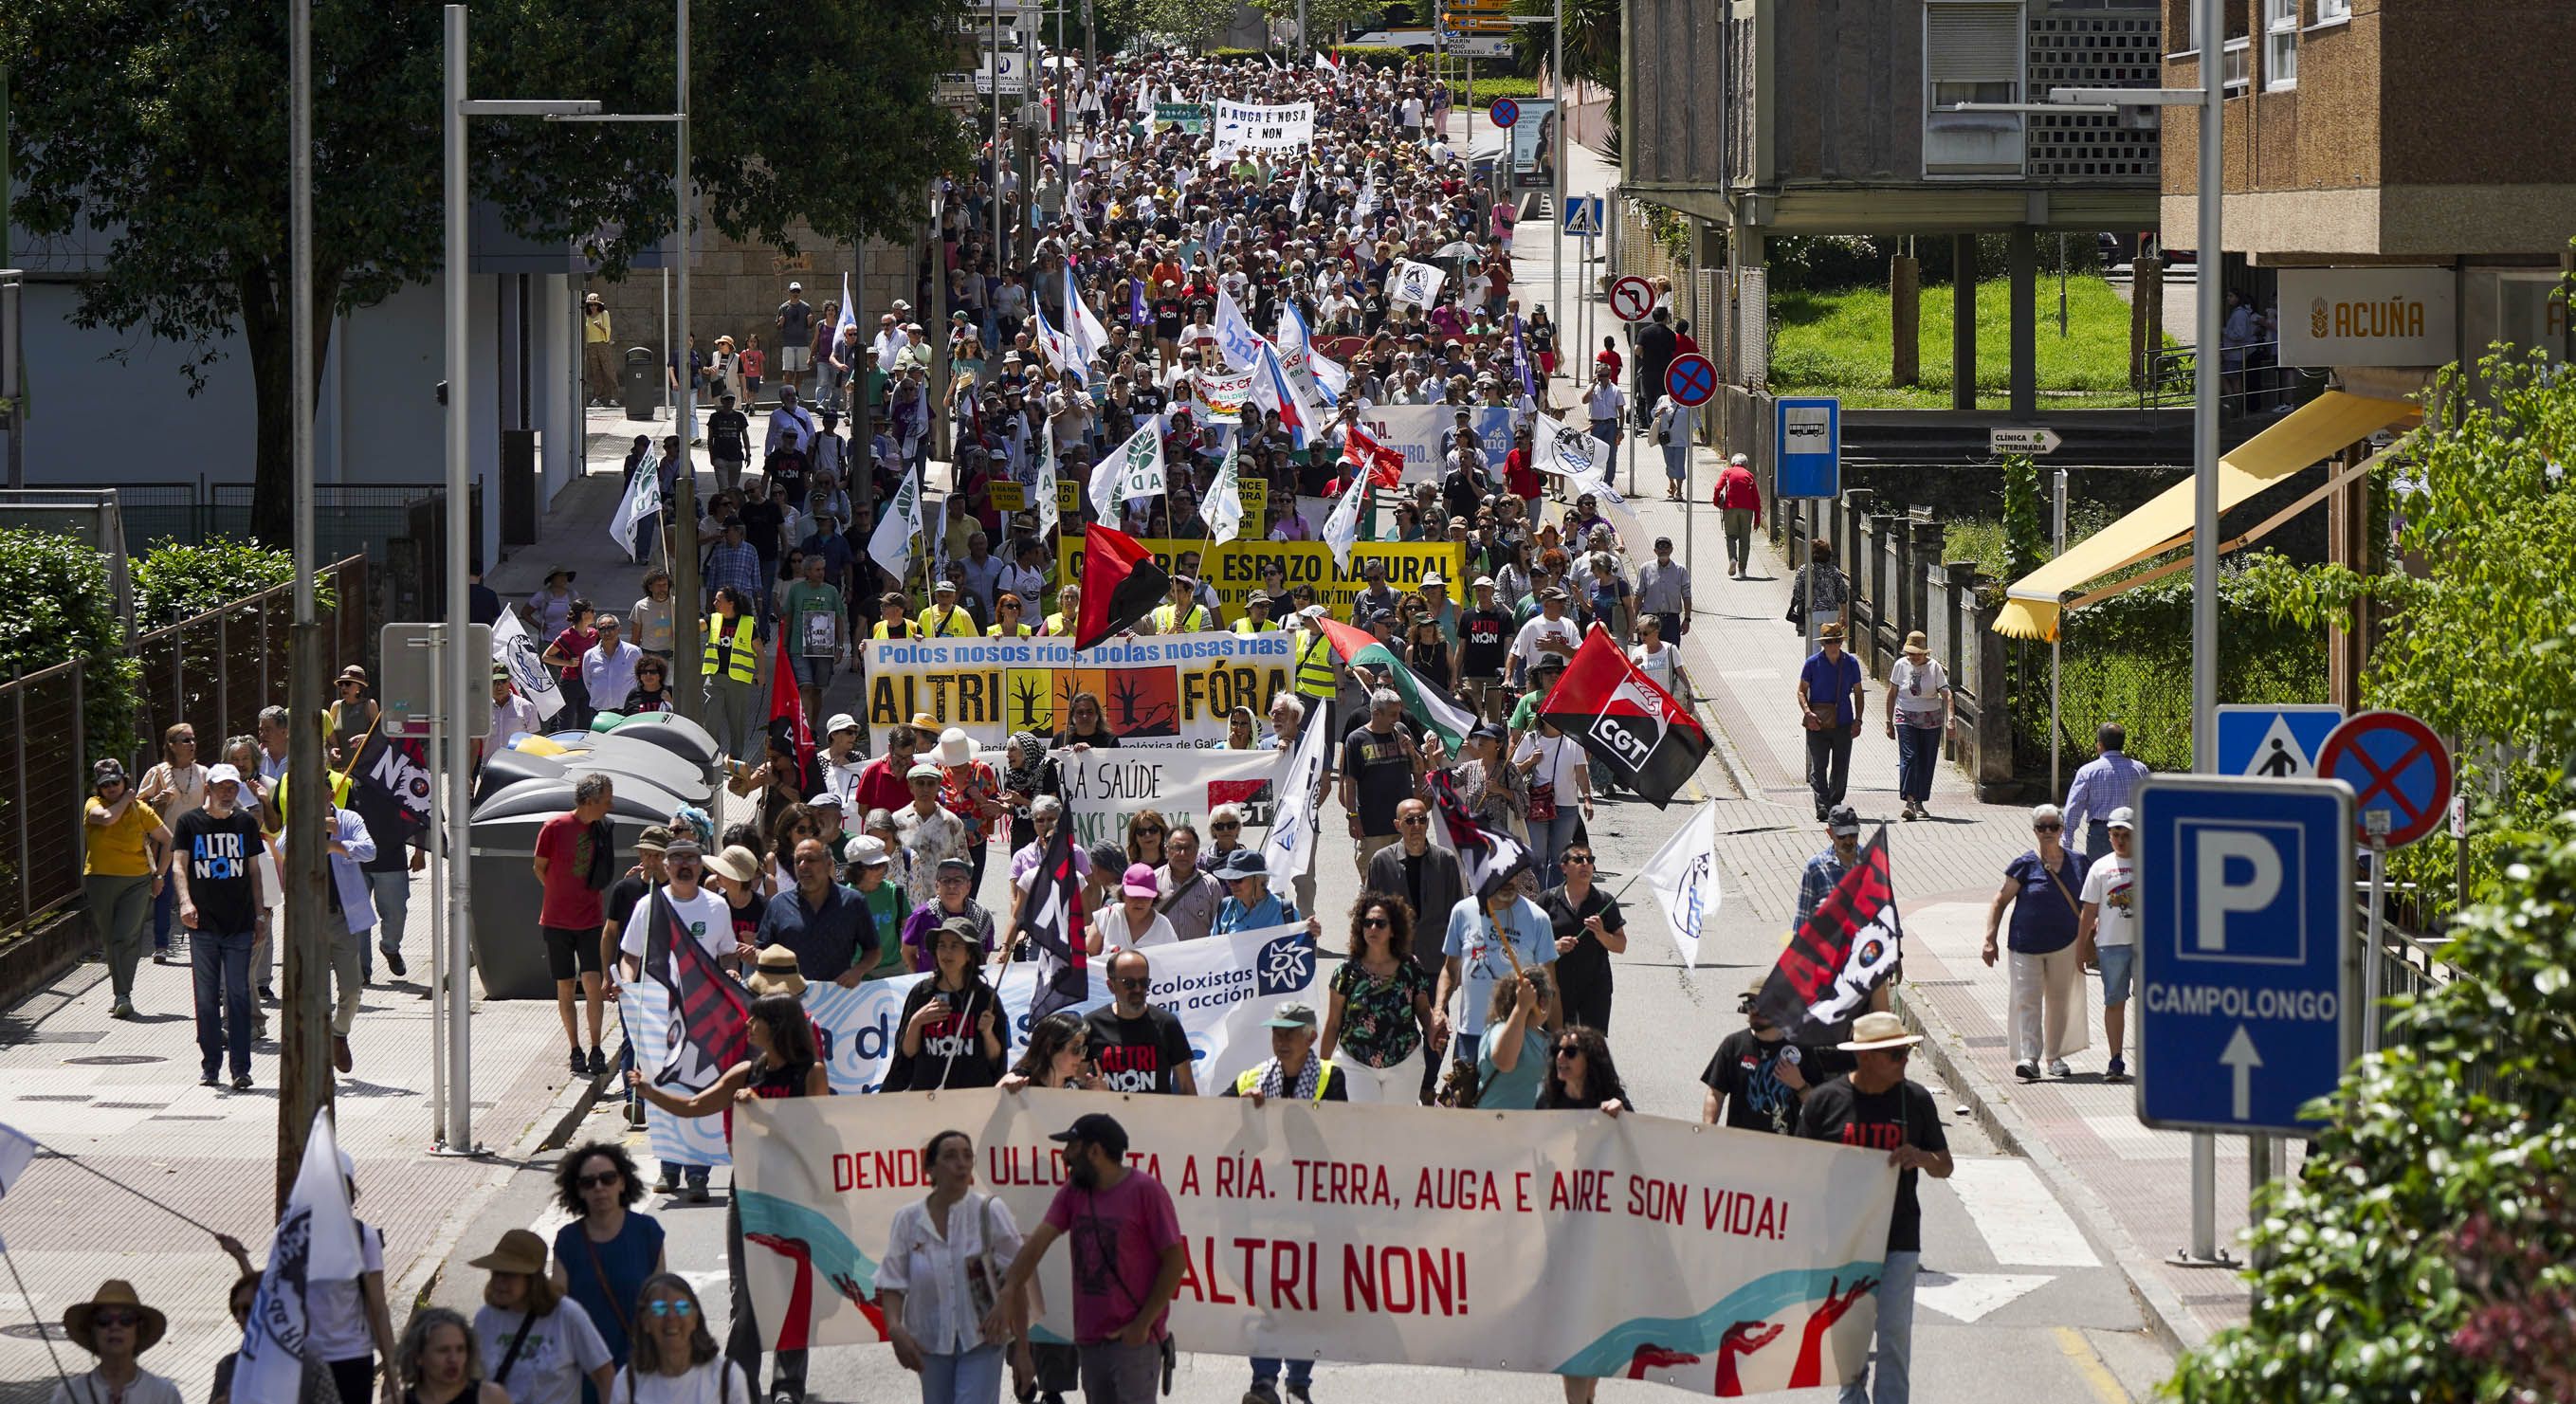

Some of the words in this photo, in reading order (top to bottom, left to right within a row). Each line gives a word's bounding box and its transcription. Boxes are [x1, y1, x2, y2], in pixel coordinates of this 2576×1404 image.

[1220, 107, 1227, 119] A
[1233, 109, 1261, 123] AUGA
[1266, 109, 1271, 123] É
[1278, 110, 1306, 122] NOSA
[1247, 128, 1252, 138] E
[1262, 128, 1282, 138] NON
[2335, 296, 2424, 337] ACUÑA
[1996, 433, 2027, 442] CLÍNICA
[1238, 481, 1262, 490] NCE
[1238, 491, 1262, 501] ORA
[1471, 620, 1500, 633] ALTRI
[1471, 633, 1498, 644] NON
[878, 645, 948, 664] Polos
[955, 645, 1032, 663] nosos
[1093, 644, 1160, 664] polas
[1165, 639, 1233, 660] nosas
[871, 671, 1000, 724] ALTRI
[1183, 660, 1289, 720] FÓRA
[1599, 719, 1649, 760] CGT
[1098, 758, 1163, 799] SAÚDE
[1236, 800, 1269, 823] GT
[193, 833, 244, 860] ALTRI
[193, 856, 245, 880] NON
[2197, 830, 2284, 951] P
[1188, 986, 1254, 1010] acción
[2147, 982, 2338, 1022] CAMPOLONGO
[925, 1036, 974, 1057] NON
[1102, 1046, 1157, 1071] ALTRI
[1103, 1070, 1156, 1091] NON
[1842, 1122, 1900, 1150] ALTR
[990, 1145, 1068, 1187] ULLO
[1130, 1152, 1163, 1184] TA
[1180, 1154, 1200, 1196] A
[1216, 1148, 1275, 1198] RÍA.
[1293, 1159, 1400, 1211] TERRA,
[1416, 1166, 1502, 1212] AUGA
[1517, 1172, 1532, 1213] E
[1549, 1170, 1614, 1213] AIRE
[1628, 1175, 1688, 1226] SON
[1704, 1188, 1788, 1240] VIDA!
[1172, 1236, 1318, 1311] ALTRI
[1343, 1243, 1469, 1317] NON!
